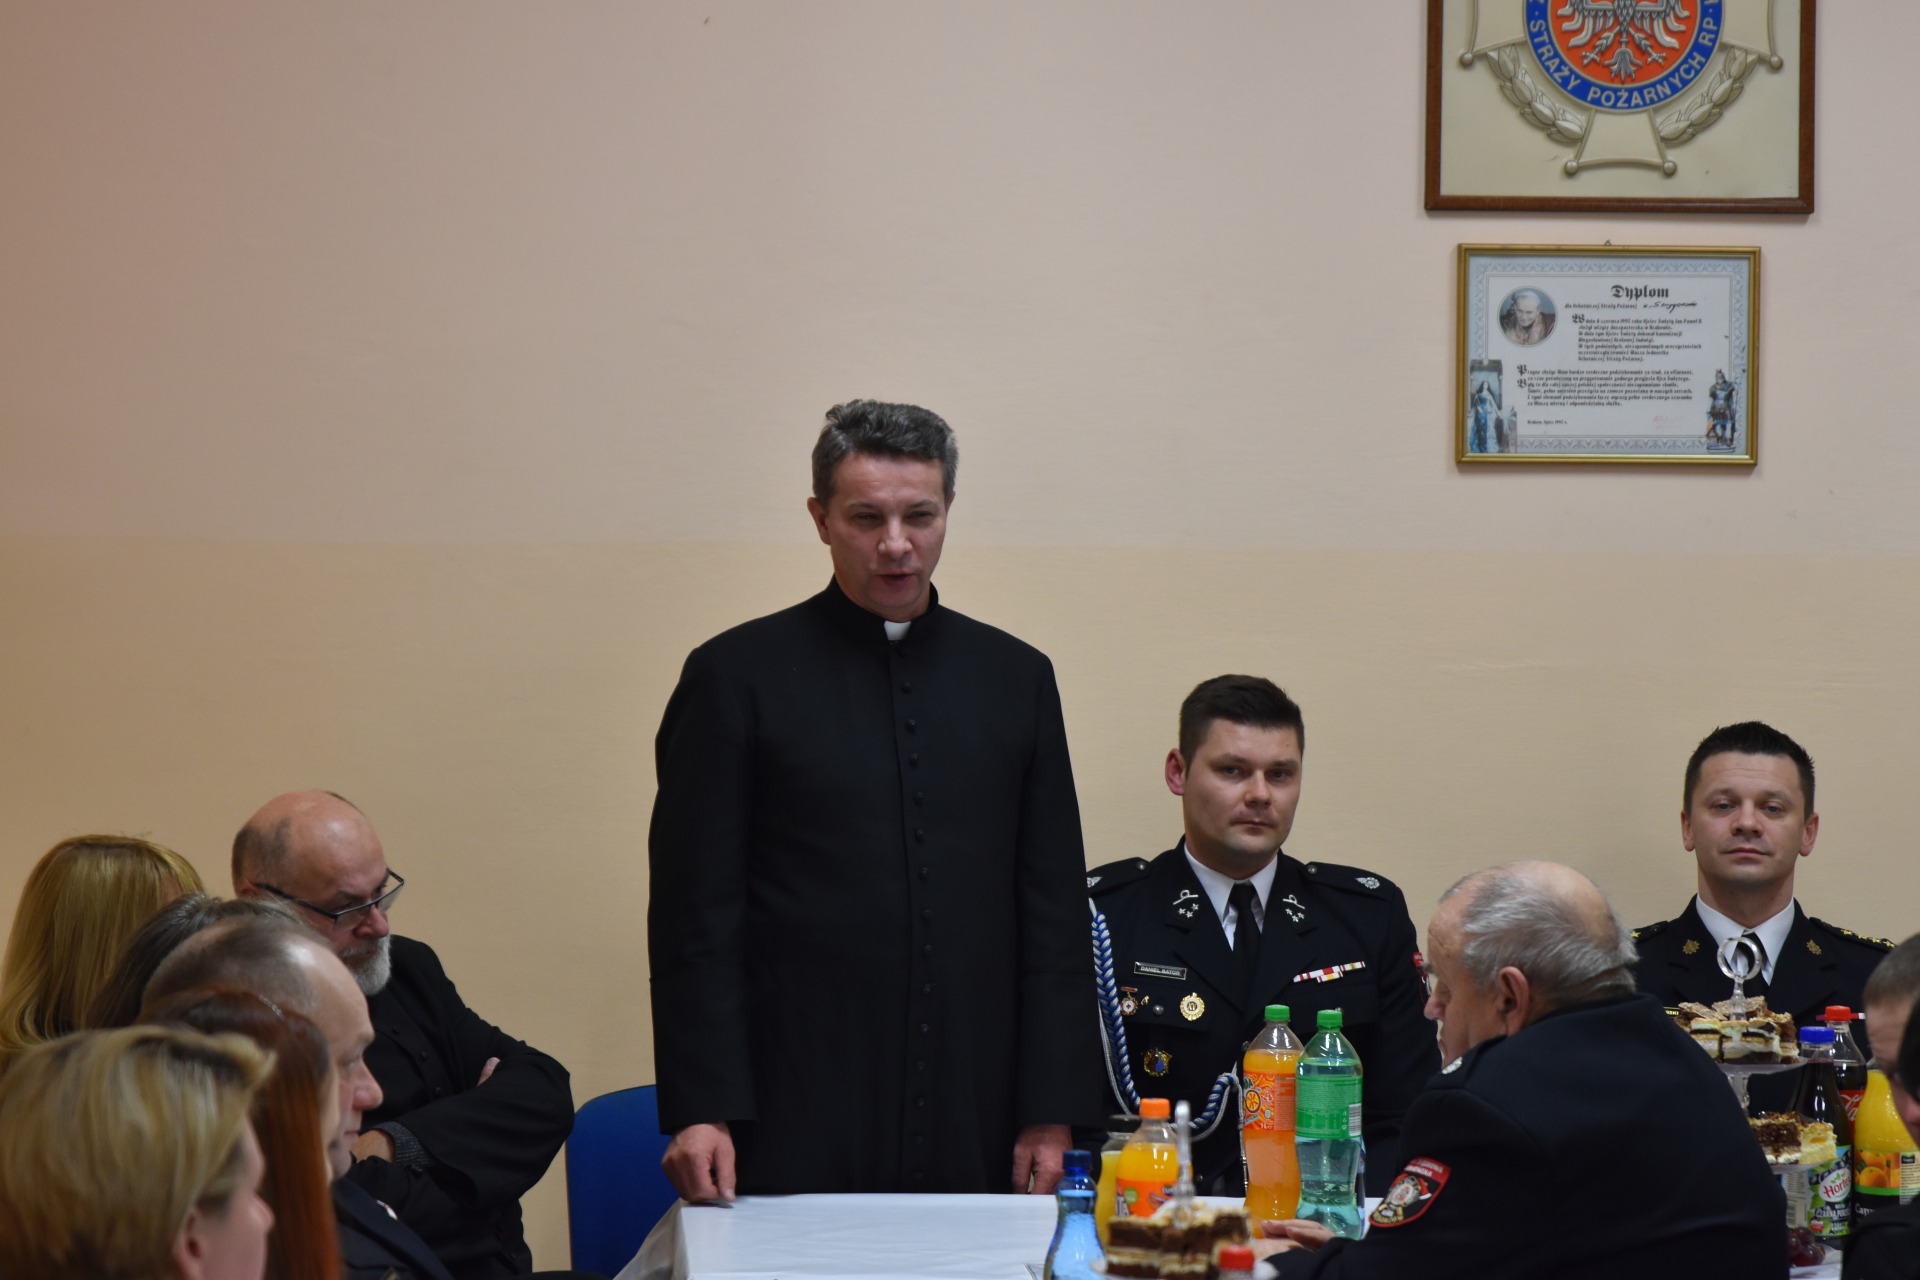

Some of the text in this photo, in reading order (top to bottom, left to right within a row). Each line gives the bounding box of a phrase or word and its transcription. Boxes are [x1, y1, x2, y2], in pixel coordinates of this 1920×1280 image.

[1530, 17, 1718, 107] STRAŻY POŻARNYCH RP
[1611, 285, 1669, 300] Dyplom
